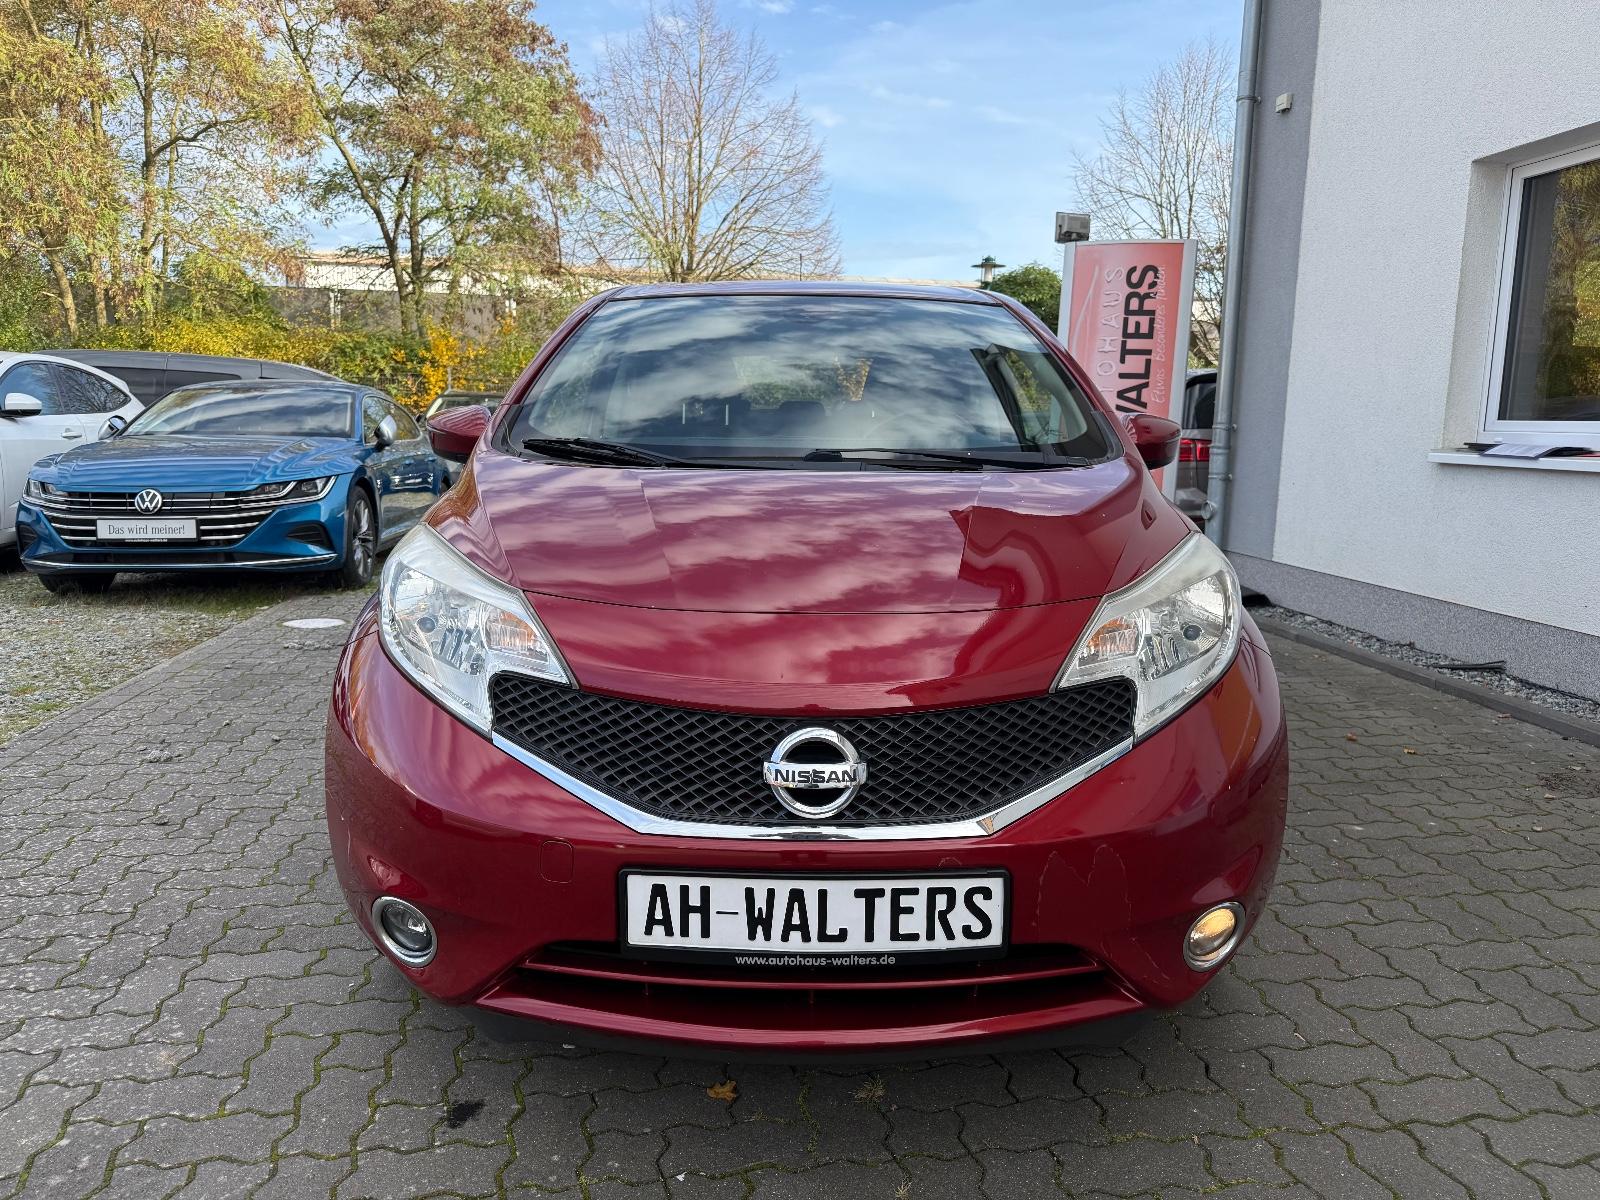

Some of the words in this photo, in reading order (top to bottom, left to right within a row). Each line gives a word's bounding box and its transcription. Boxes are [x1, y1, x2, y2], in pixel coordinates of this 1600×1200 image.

[108, 525, 125, 535] Das
[128, 525, 148, 535] wird
[151, 525, 185, 535] meiner!
[774, 768, 857, 784] NISSAN
[644, 883, 992, 943] AH-WALTERS
[735, 955, 896, 966] www.autohaus-walters.de
